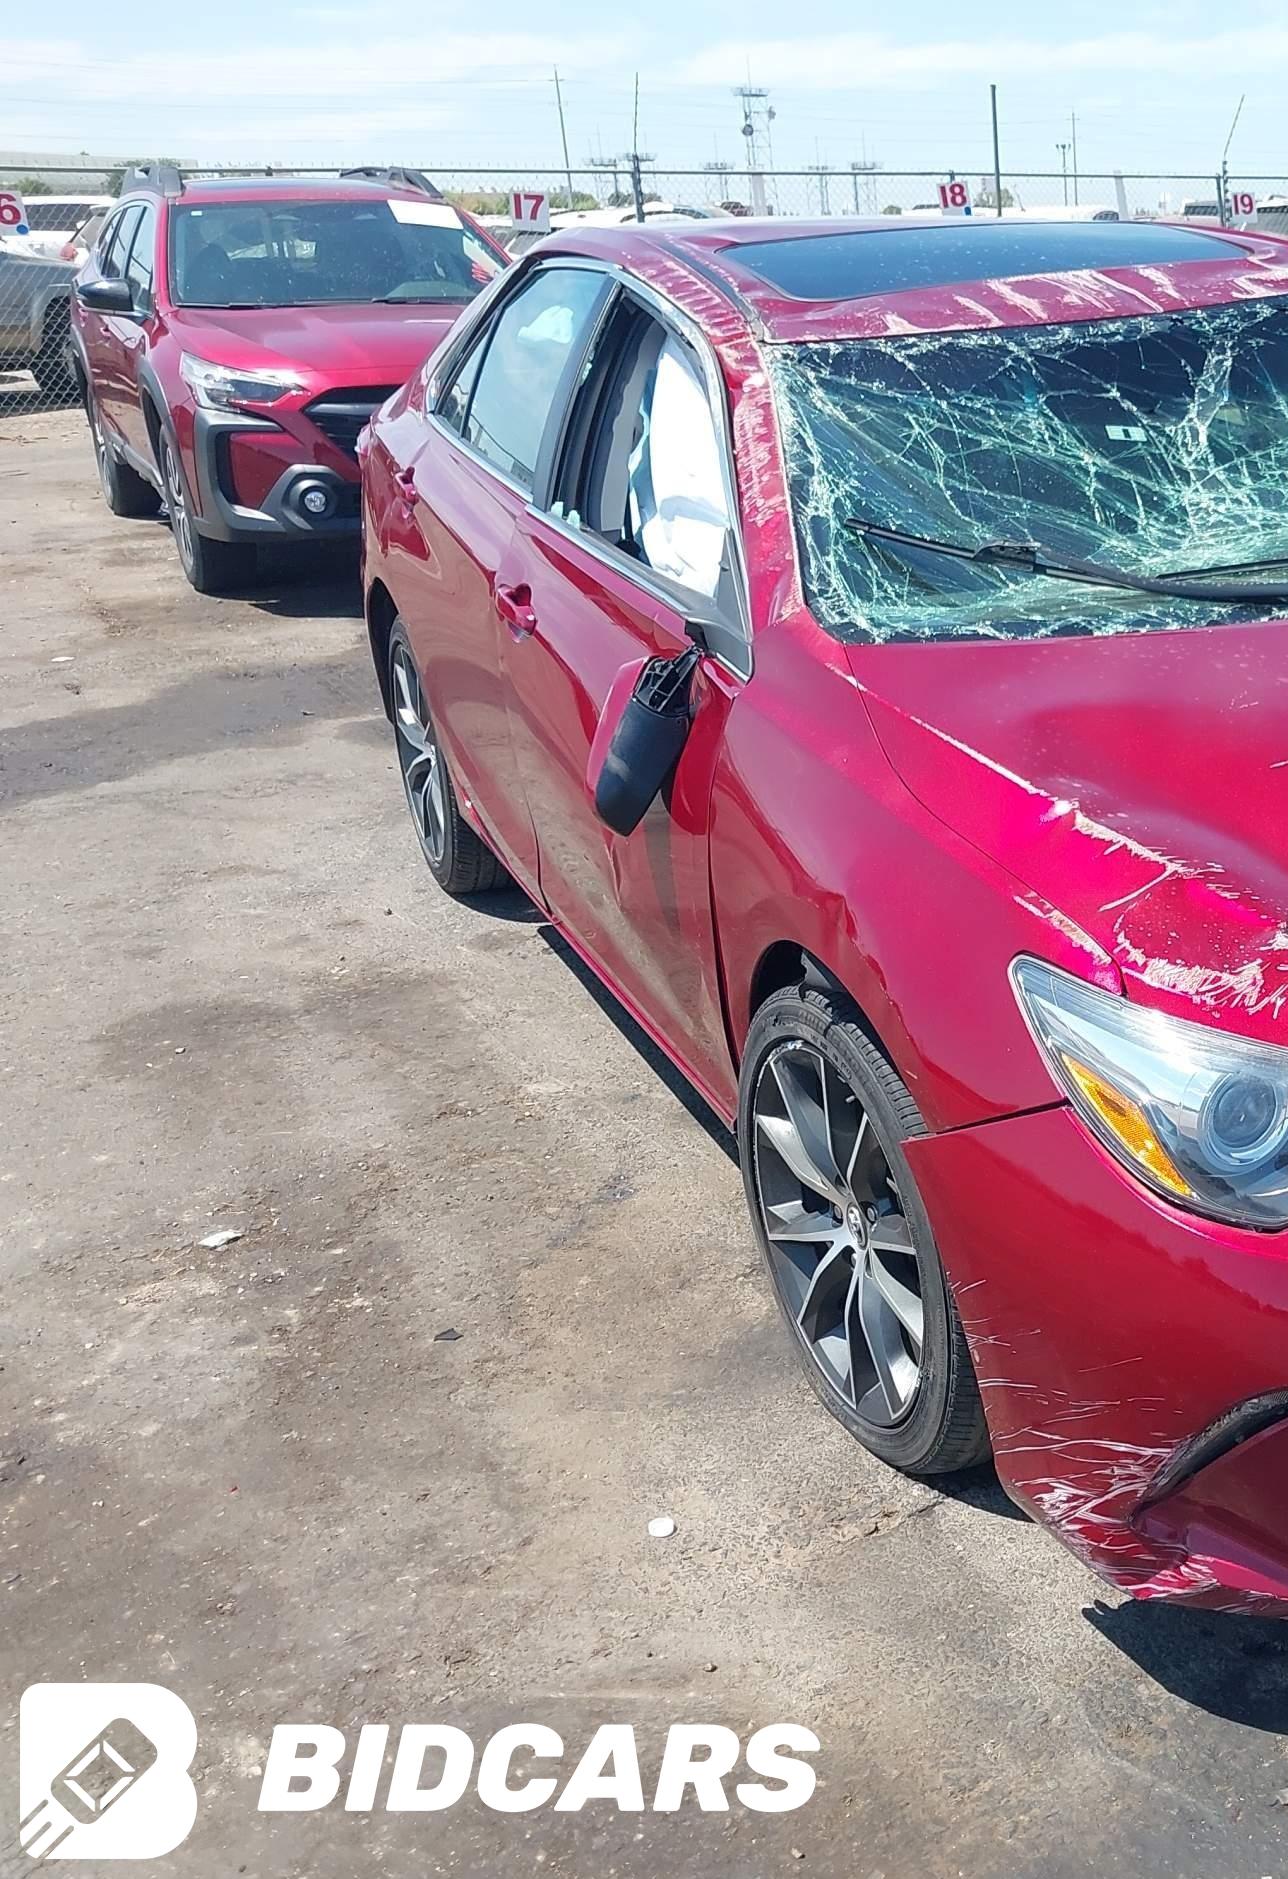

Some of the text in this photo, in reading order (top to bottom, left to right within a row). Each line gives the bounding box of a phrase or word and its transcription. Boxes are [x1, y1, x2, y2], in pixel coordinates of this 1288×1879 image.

[513, 193, 544, 220] 17
[940, 183, 967, 208] 18
[1233, 194, 1253, 215] 19
[0, 193, 21, 225] 6
